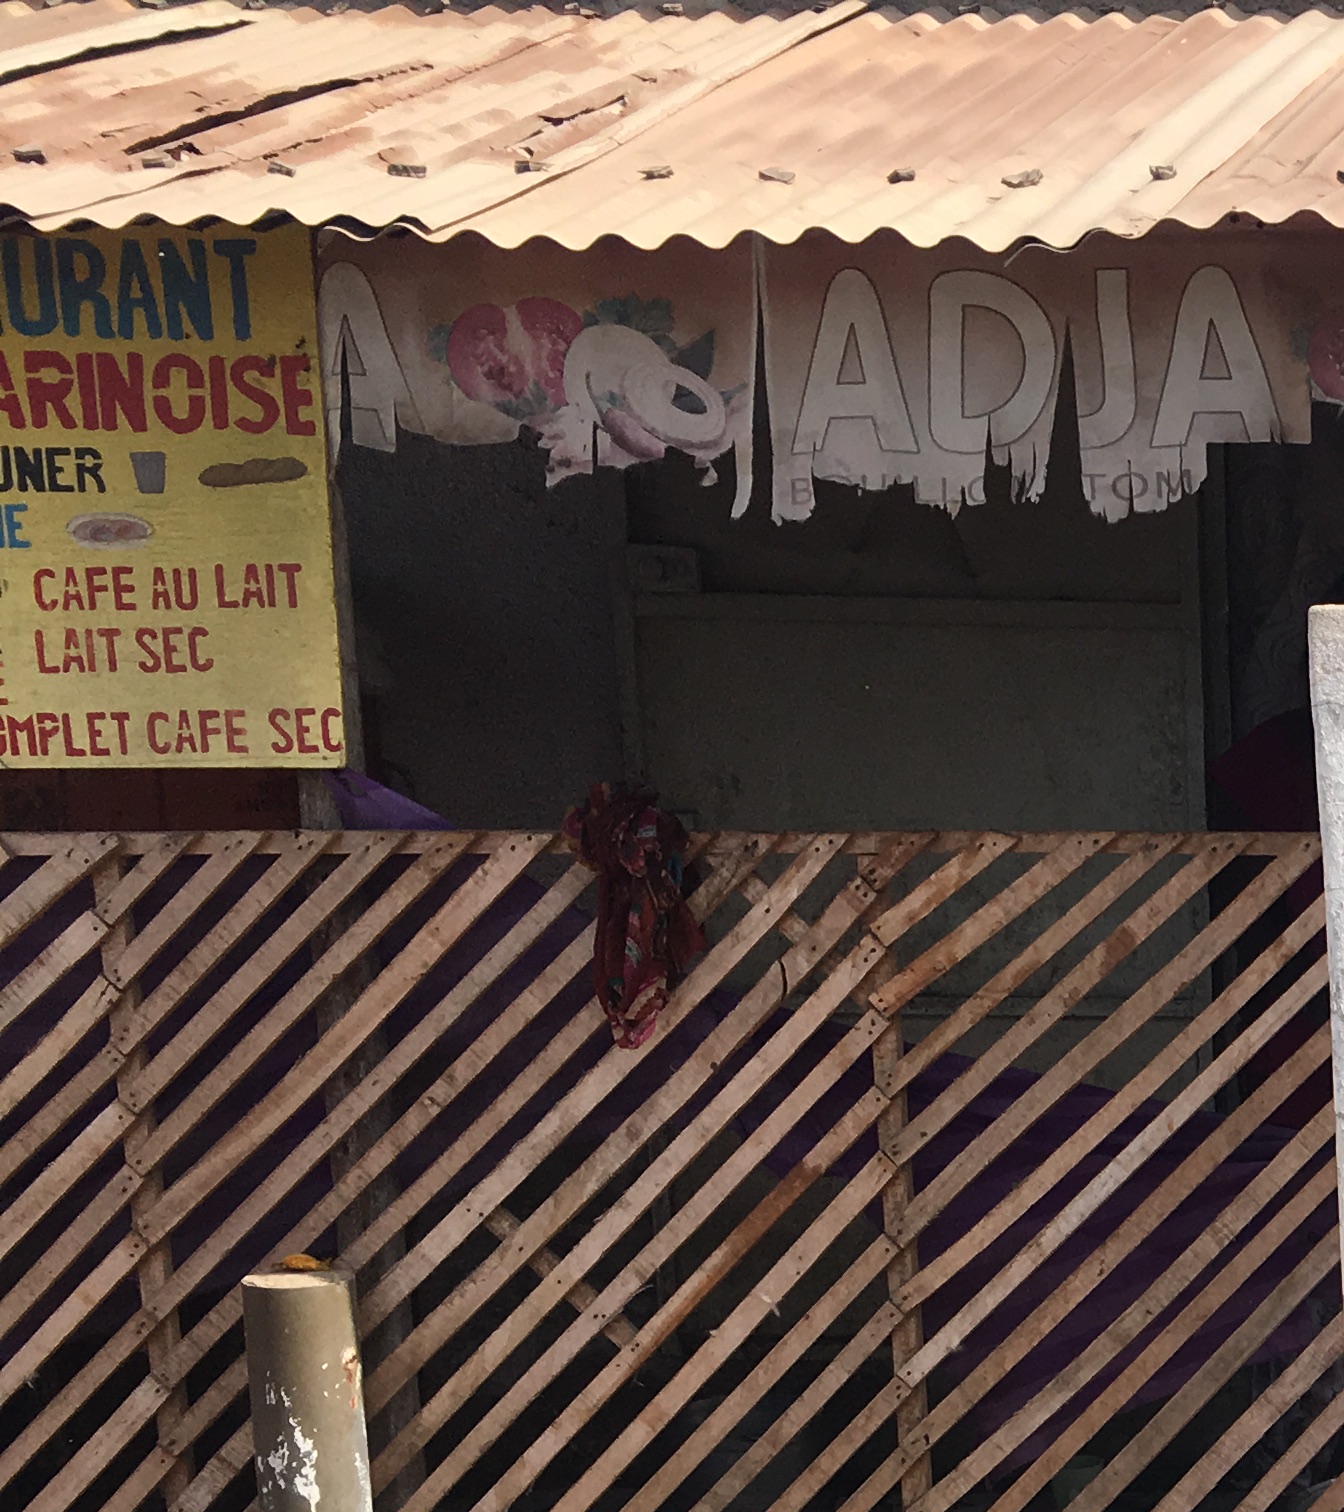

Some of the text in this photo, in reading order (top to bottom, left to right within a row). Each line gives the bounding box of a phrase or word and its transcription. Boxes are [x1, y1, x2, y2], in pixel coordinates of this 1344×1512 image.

[0, 238, 256, 342] URANT
[791, 266, 1282, 455] ADJA
[33, 563, 302, 611] CAFE AU LAIT
[34, 627, 214, 673] LAIT SEC
[0, 707, 344, 757] MPLET CAFE SEC
